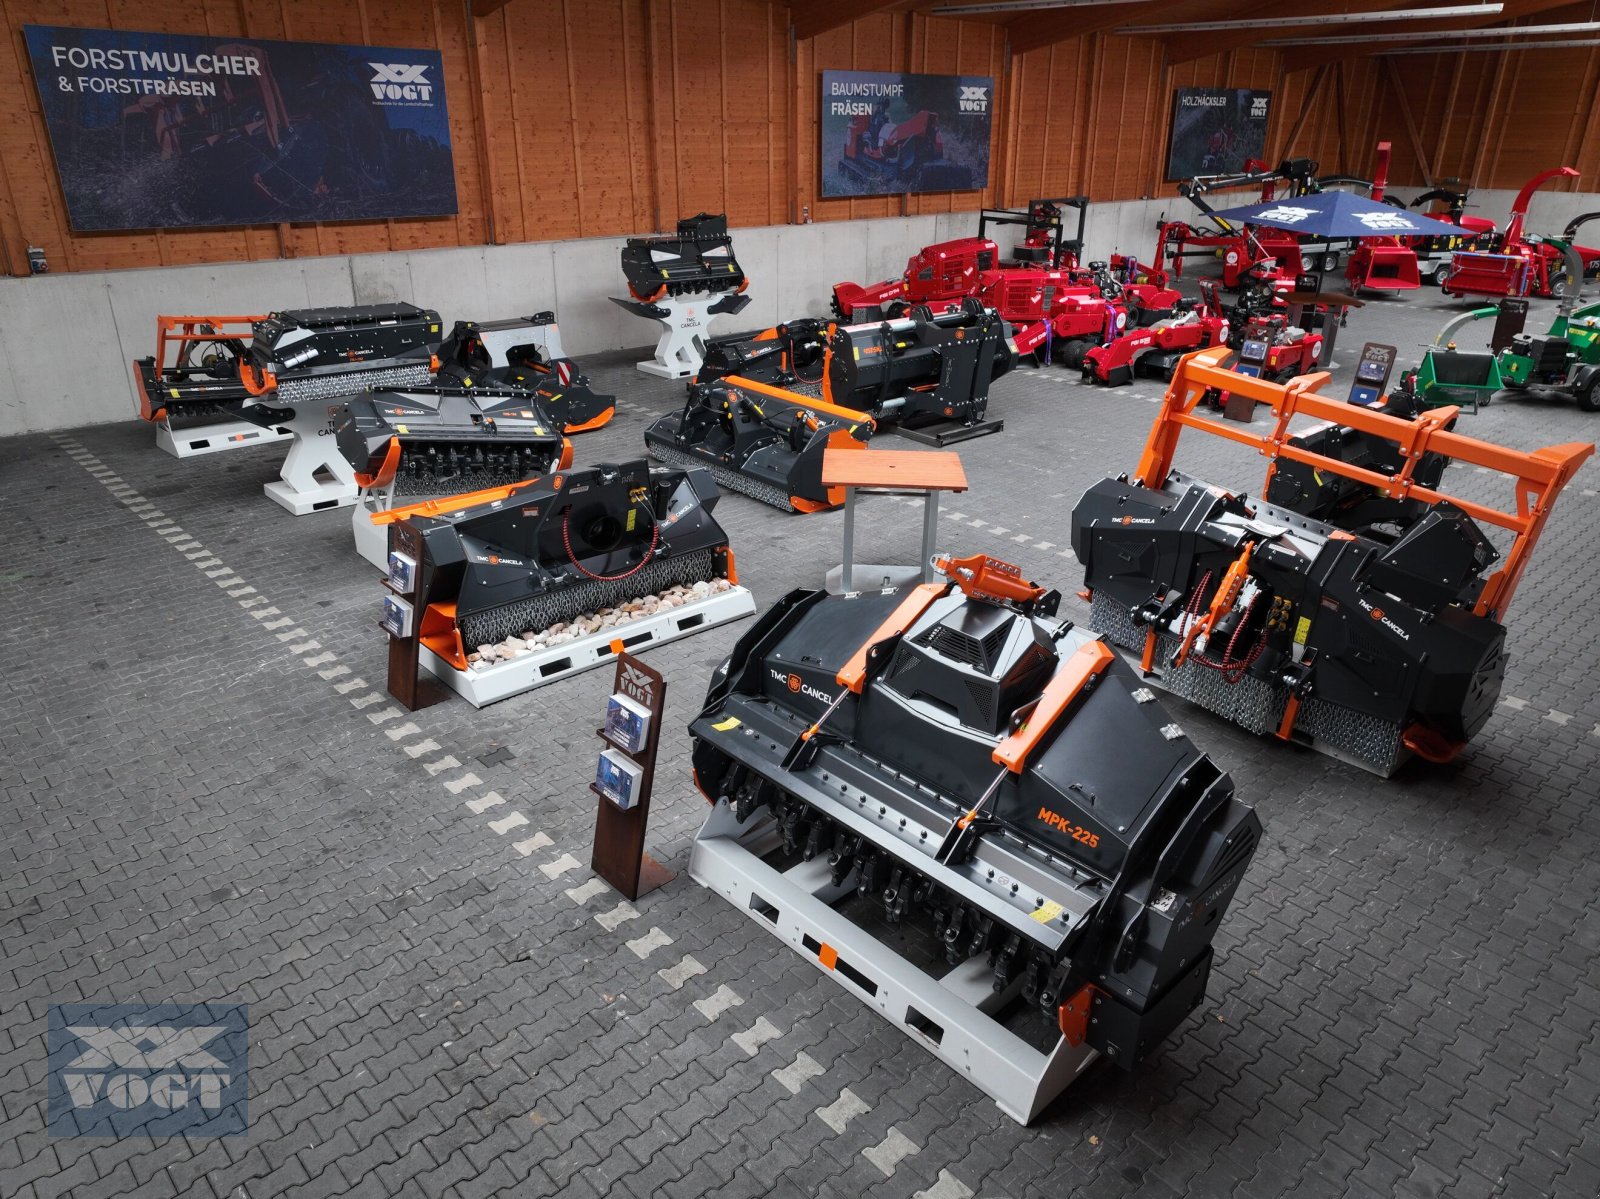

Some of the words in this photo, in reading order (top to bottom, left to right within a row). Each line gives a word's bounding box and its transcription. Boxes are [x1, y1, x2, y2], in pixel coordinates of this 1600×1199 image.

[51, 46, 262, 76] FORSTMULCHER
[58, 75, 74, 92] &
[77, 76, 216, 96] FORSTFRÄSEN
[370, 83, 433, 101] VOGT
[831, 82, 904, 97] BAUMSTUMPF
[831, 100, 873, 116] FRÄSEN
[959, 100, 988, 112] VOGT
[1181, 94, 1227, 106] HOLZHÄCKSLER
[675, 502, 694, 517] CANCELA
[498, 557, 523, 566] CANCELA
[1358, 598, 1373, 612] TMC
[1381, 616, 1410, 641] CANCELA
[620, 676, 654, 706] VOGT
[770, 669, 788, 684] TMC
[801, 684, 840, 709] CANCEL
[1037, 806, 1101, 850] MPK-225
